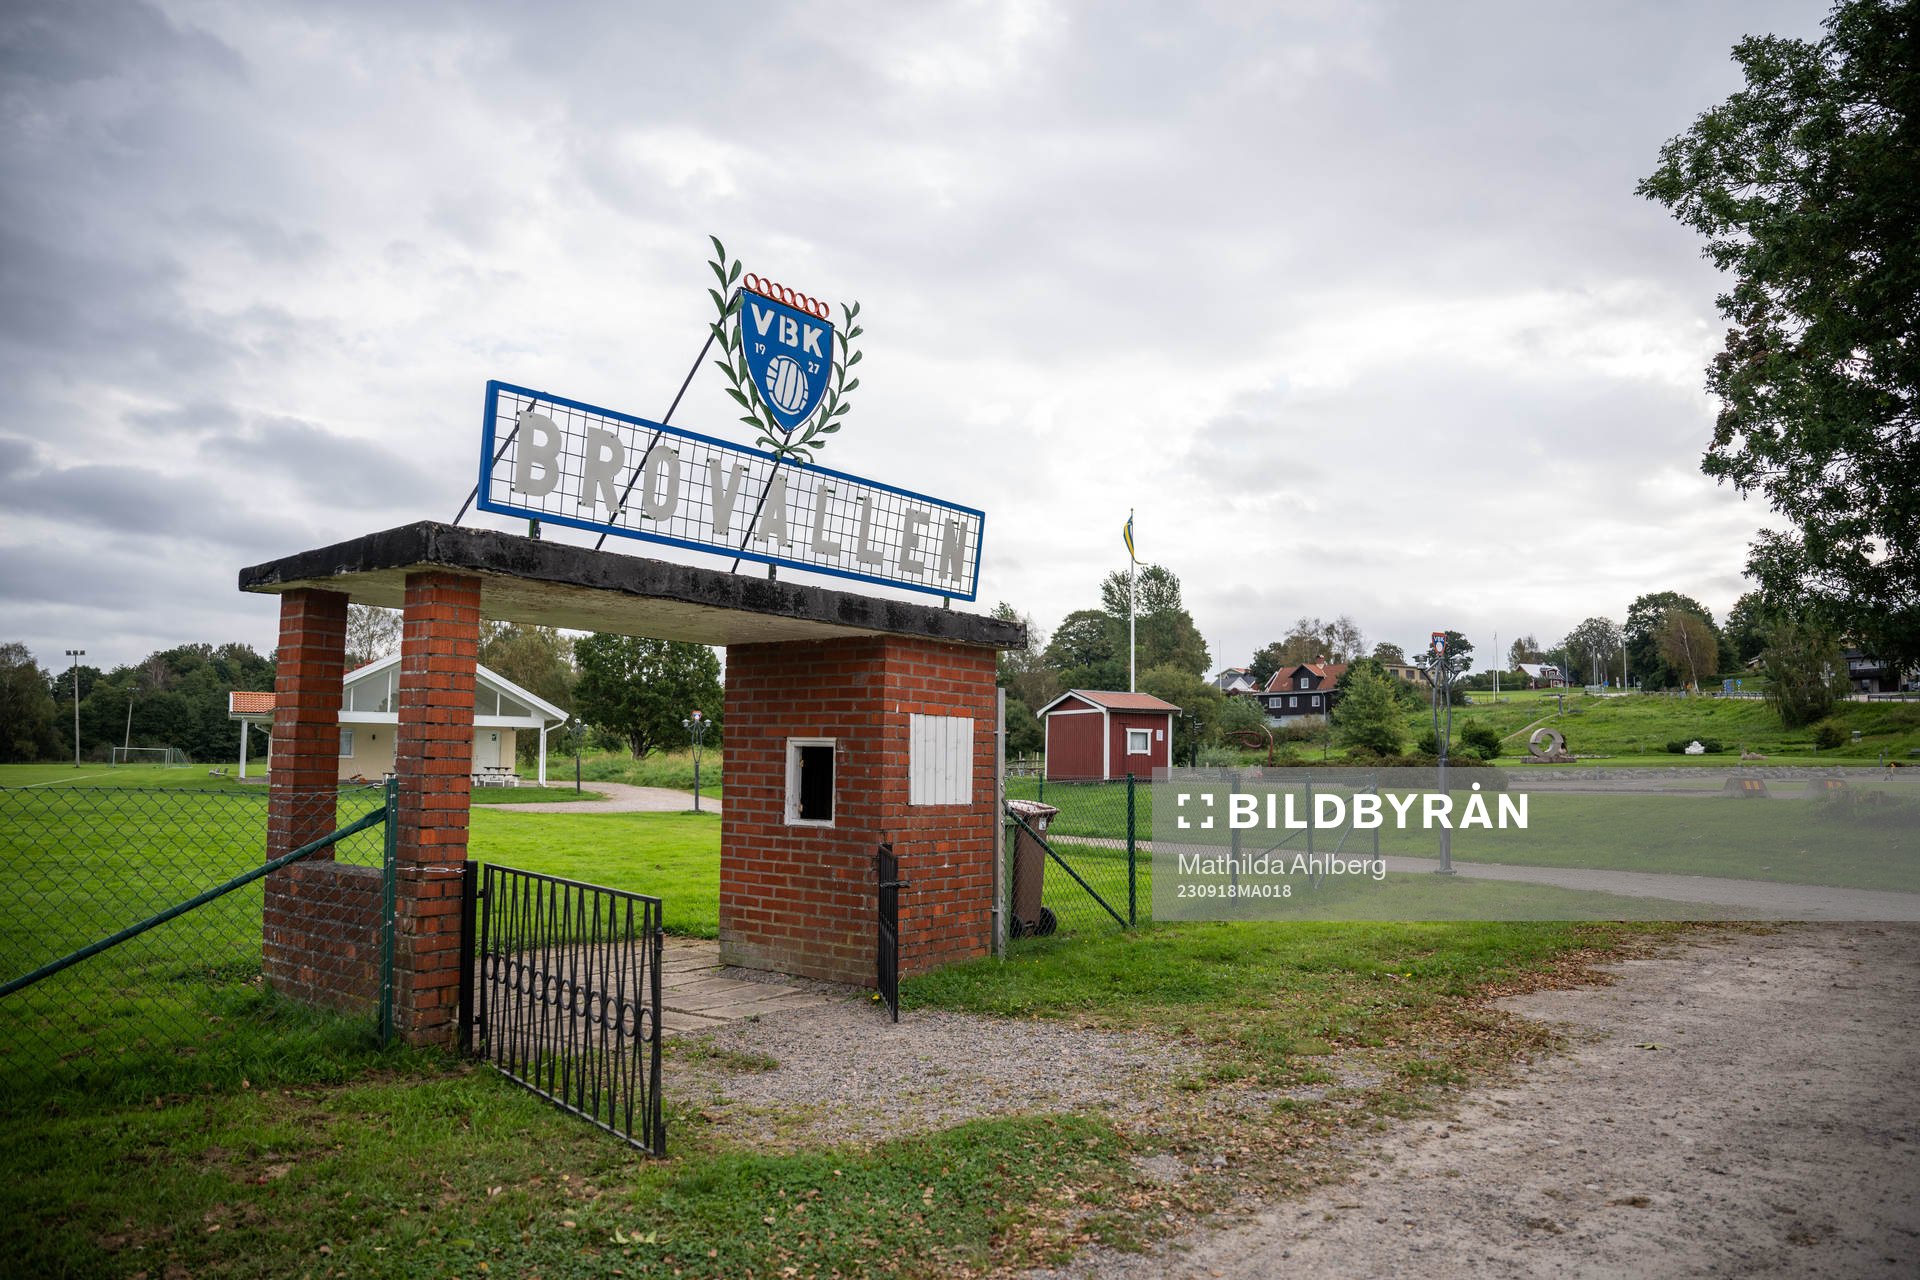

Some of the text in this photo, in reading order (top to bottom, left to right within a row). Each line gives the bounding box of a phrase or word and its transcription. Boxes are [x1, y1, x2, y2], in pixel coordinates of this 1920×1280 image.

[751, 302, 824, 358] VBK
[755, 342, 820, 375] 19 27
[513, 410, 967, 582] BROVALLEN
